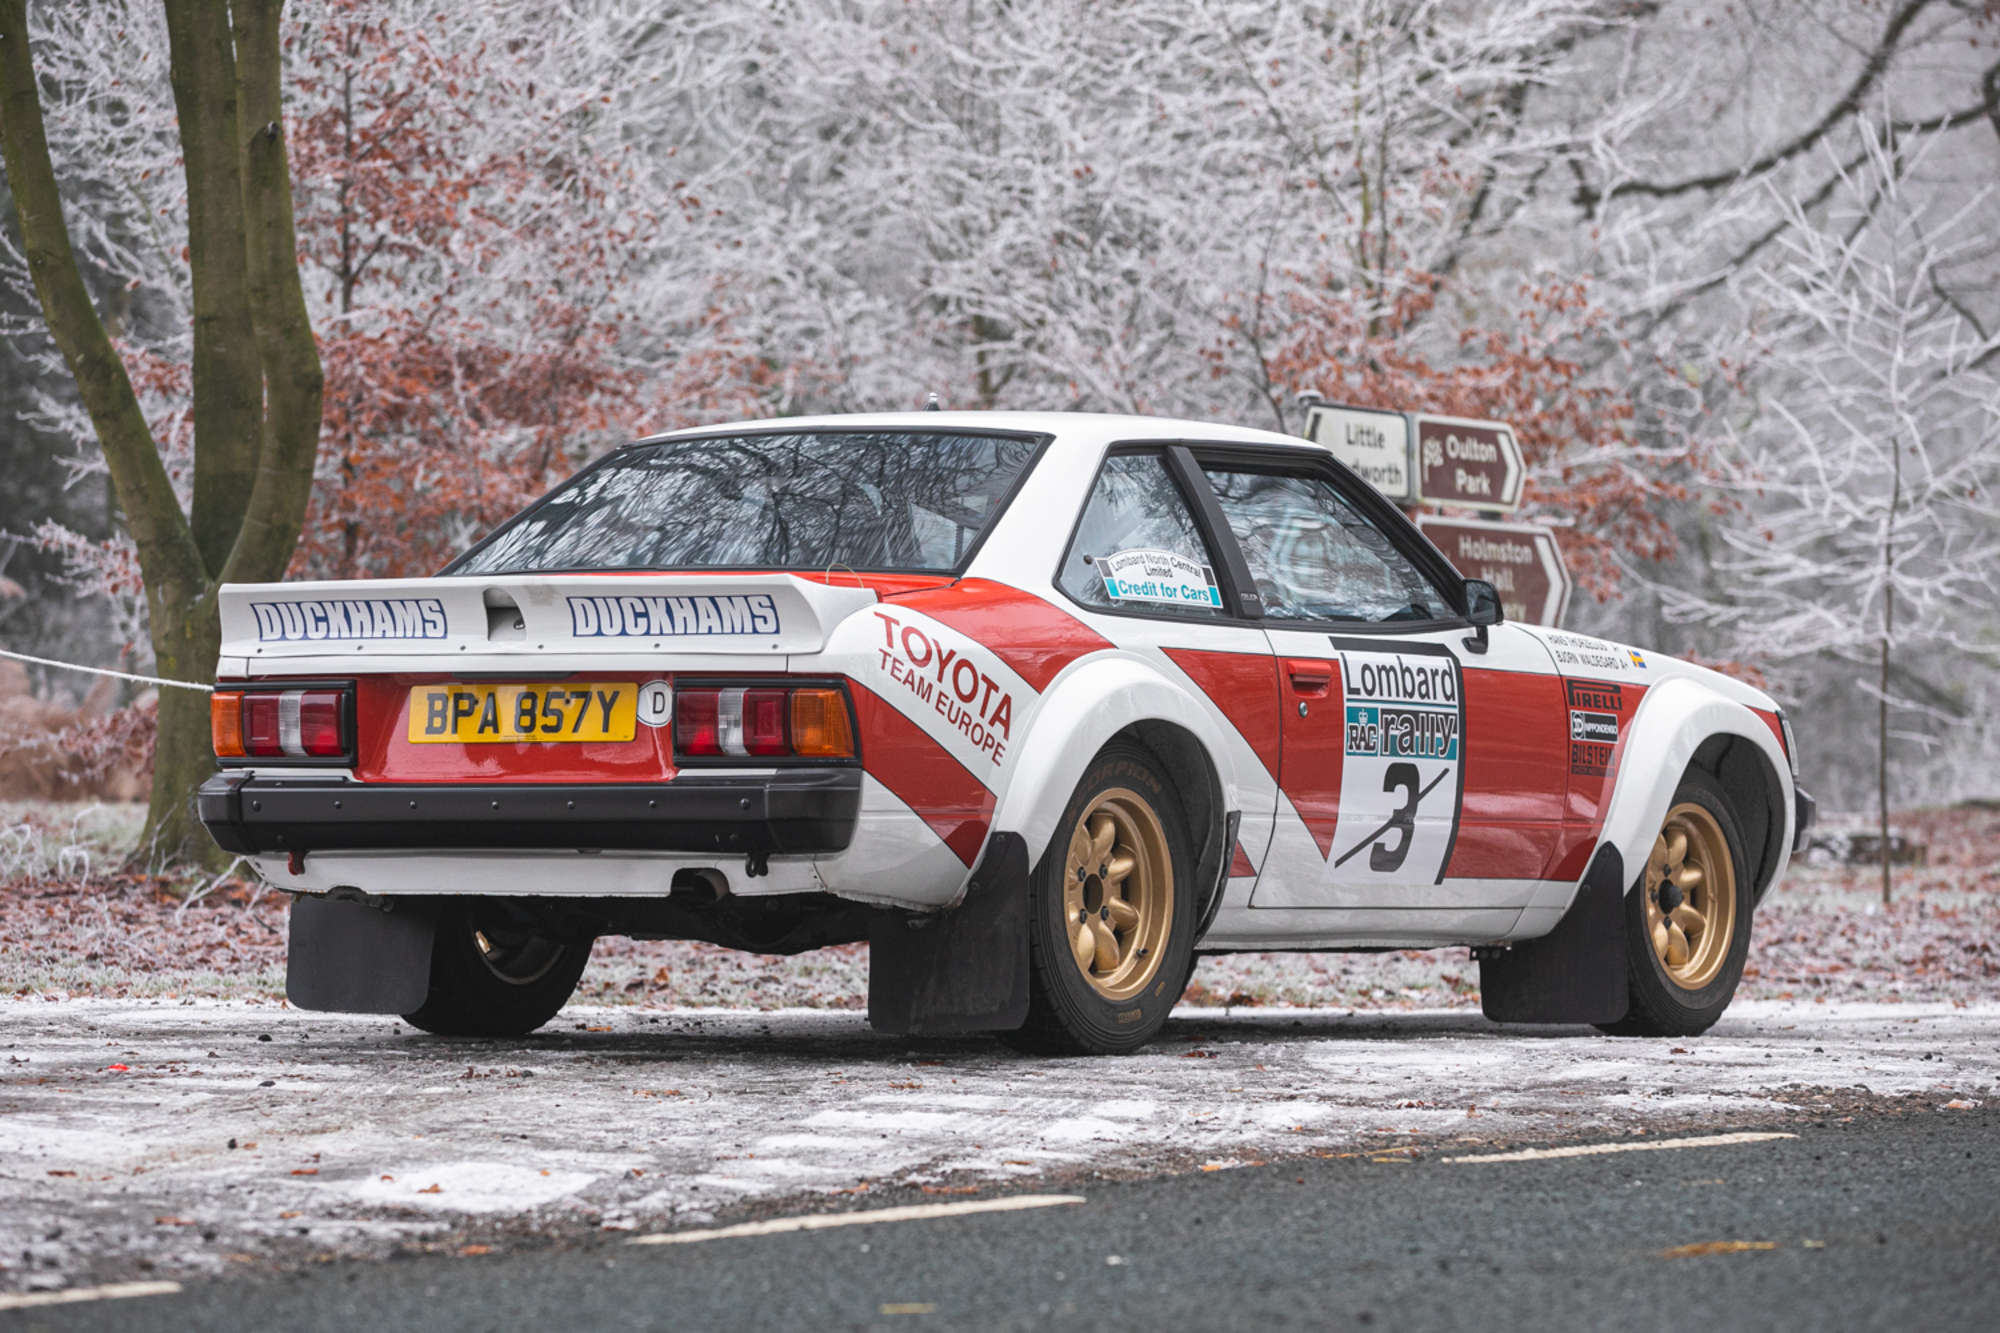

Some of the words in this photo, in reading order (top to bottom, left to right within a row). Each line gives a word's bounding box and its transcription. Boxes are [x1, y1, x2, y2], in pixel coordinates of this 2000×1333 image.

[1345, 421, 1385, 449] Little
[1446, 434, 1497, 463] Oulton
[1351, 457, 1402, 485] dworth
[1455, 468, 1491, 496] Park
[1459, 536, 1532, 564] Holmston
[1111, 553, 1146, 572] Lombard
[1145, 552, 1170, 567] North
[1170, 556, 1202, 578] Central
[1144, 564, 1174, 578] Limited
[1118, 579, 1158, 597] Credit
[1160, 582, 1178, 599] for
[1180, 584, 1210, 601] Cars
[251, 599, 447, 641] DUCKHAMS
[567, 595, 780, 637] DUCKHAMS
[873, 611, 1013, 742] TOYOTA
[1340, 651, 1456, 702] Lombard
[652, 691, 666, 715] D
[878, 648, 933, 704] TEAM
[934, 691, 1006, 768] EUROPE
[1566, 679, 1623, 711] PIRELLI
[425, 692, 501, 735] BPA
[514, 690, 620, 735] 857Y
[1348, 723, 1379, 753] RAC
[1380, 711, 1458, 759] rally
[1571, 743, 1616, 767] BILSTEIN
